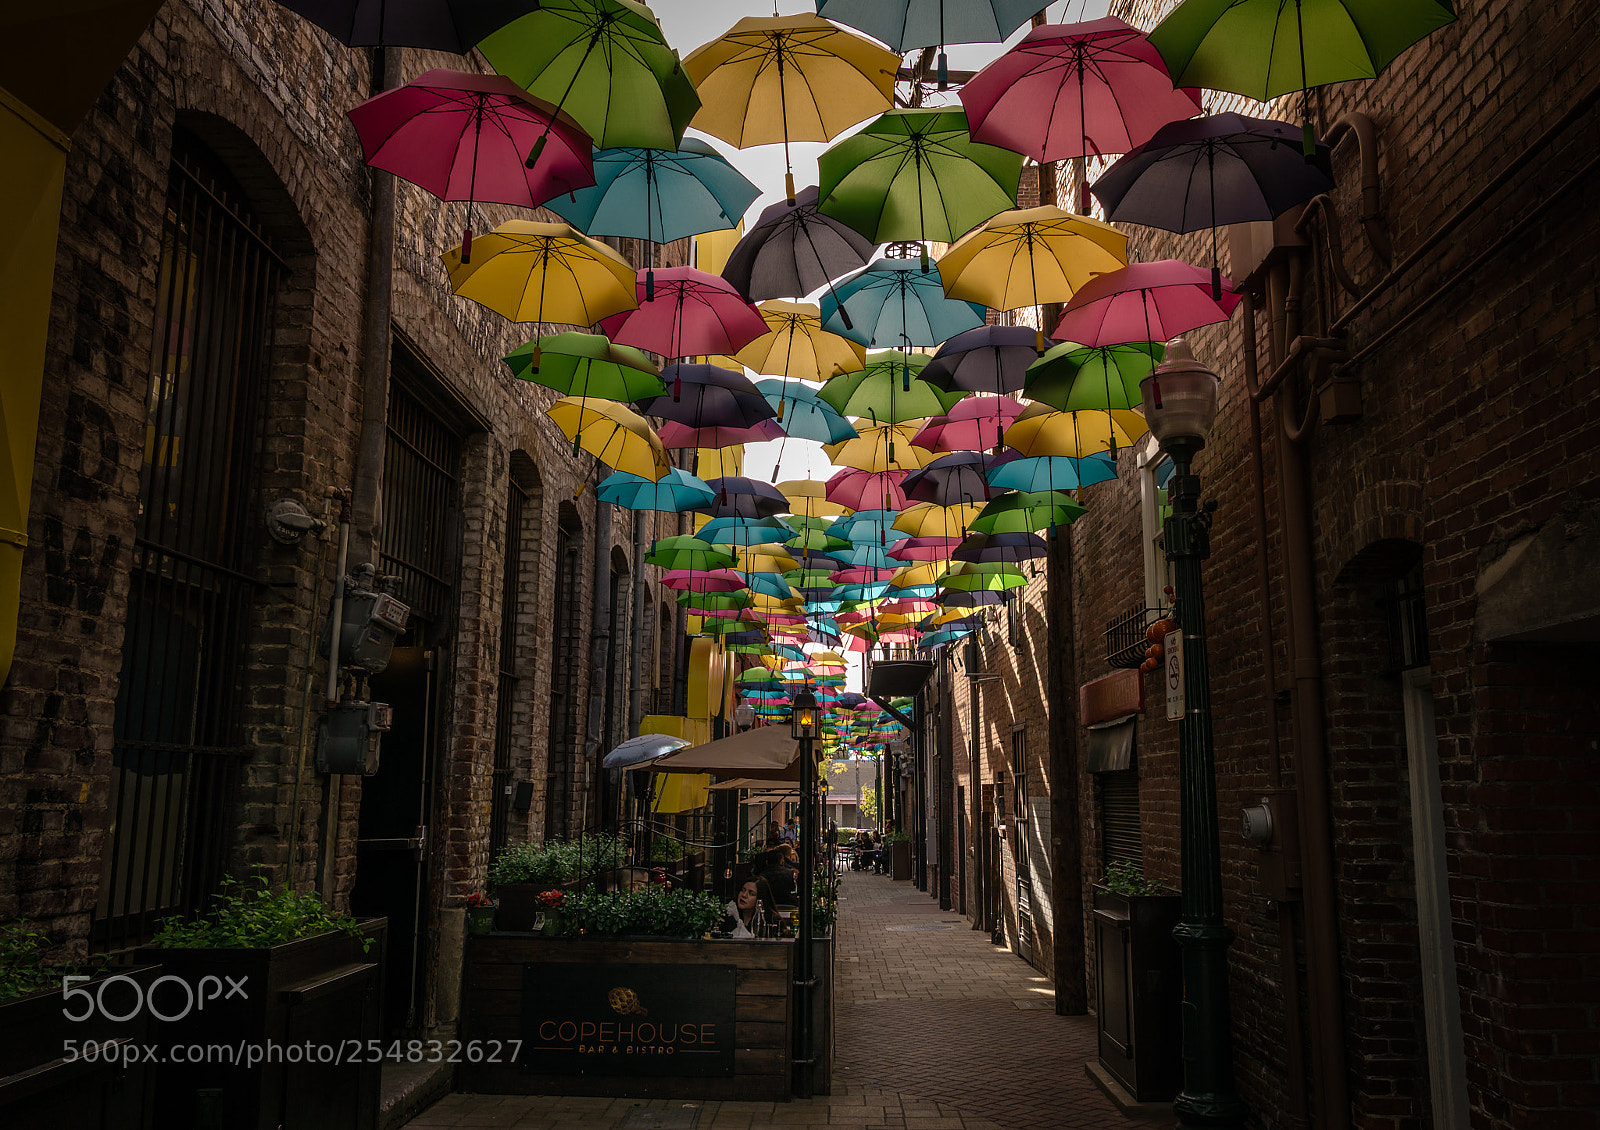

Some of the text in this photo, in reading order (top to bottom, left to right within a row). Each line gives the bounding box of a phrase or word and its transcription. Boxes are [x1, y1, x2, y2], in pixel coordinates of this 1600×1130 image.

[538, 1020, 716, 1044] COPEHOUSE
[578, 1044, 675, 1055] BAR & BISTRO
